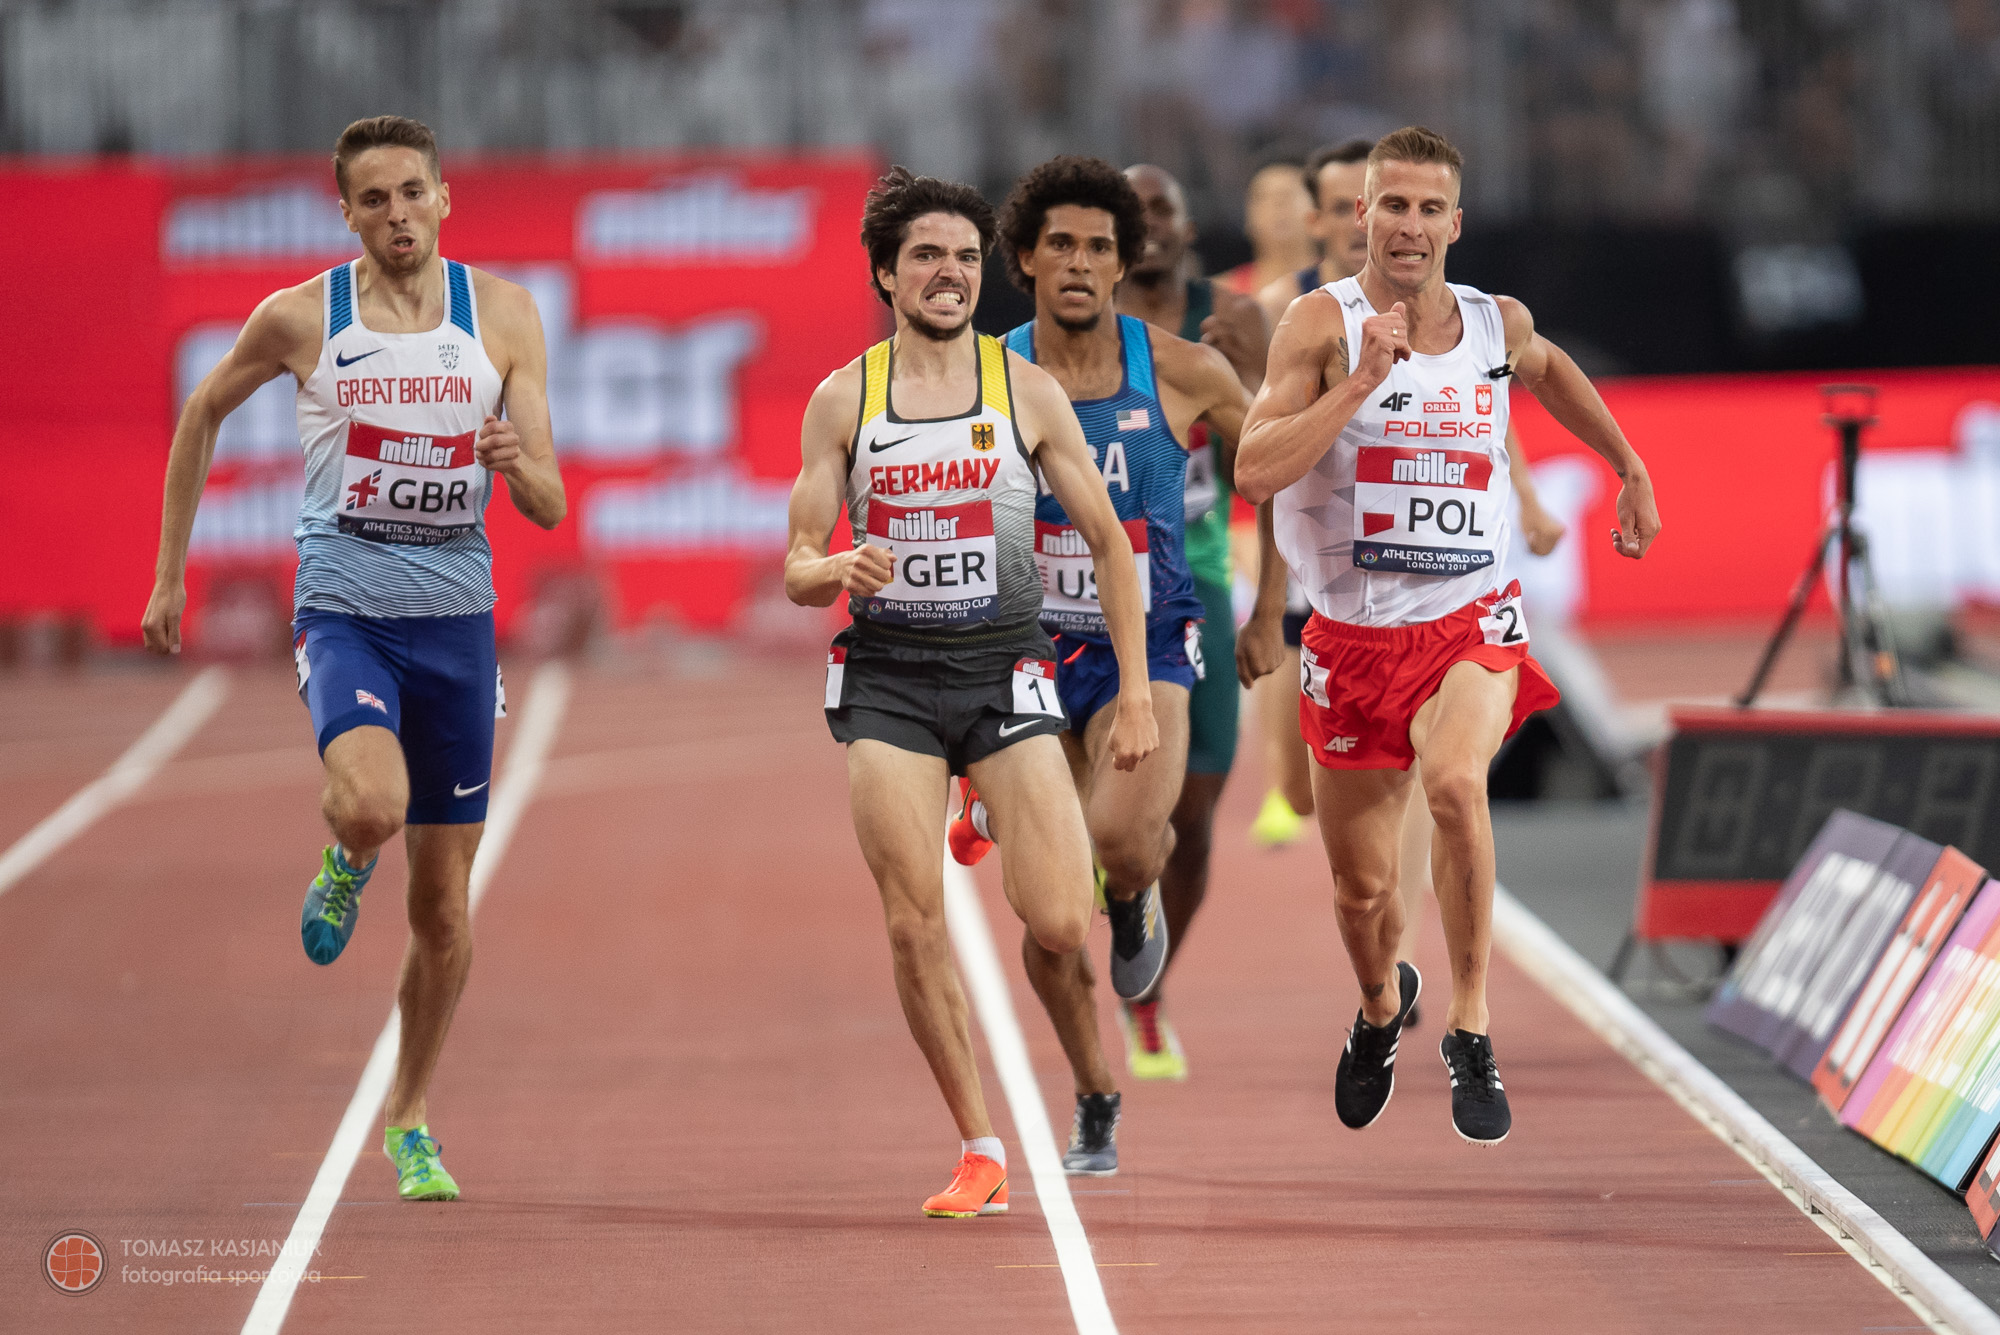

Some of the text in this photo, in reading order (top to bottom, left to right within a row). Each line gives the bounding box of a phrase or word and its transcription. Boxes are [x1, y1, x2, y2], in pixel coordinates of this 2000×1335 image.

[336, 375, 472, 407] GREAT BRITAIN
[1425, 403, 1459, 412] ORLEN
[1384, 420, 1492, 438] POLSKA
[378, 436, 456, 468] müller
[869, 458, 1001, 496] GERMANY
[1391, 451, 1470, 486] müller
[388, 478, 469, 513] GBR
[362, 521, 413, 535] ATHLETICS
[414, 526, 450, 537] WORLD
[887, 510, 960, 541] müller
[1408, 497, 1485, 537] POL
[386, 533, 423, 542] LONDON
[1381, 549, 1490, 564] ATHLETICS WORLD CUP
[1406, 561, 1467, 571] LONDON 2018
[902, 551, 987, 588] GER
[884, 597, 992, 612] ATHLETICS WORLD CUP
[907, 610, 968, 619] LONDON 2018
[1038, 611, 1086, 623] ATHLETICS
[1060, 623, 1096, 631] LONDON
[1496, 605, 1524, 643] 2
[1028, 678, 1047, 711] 1
